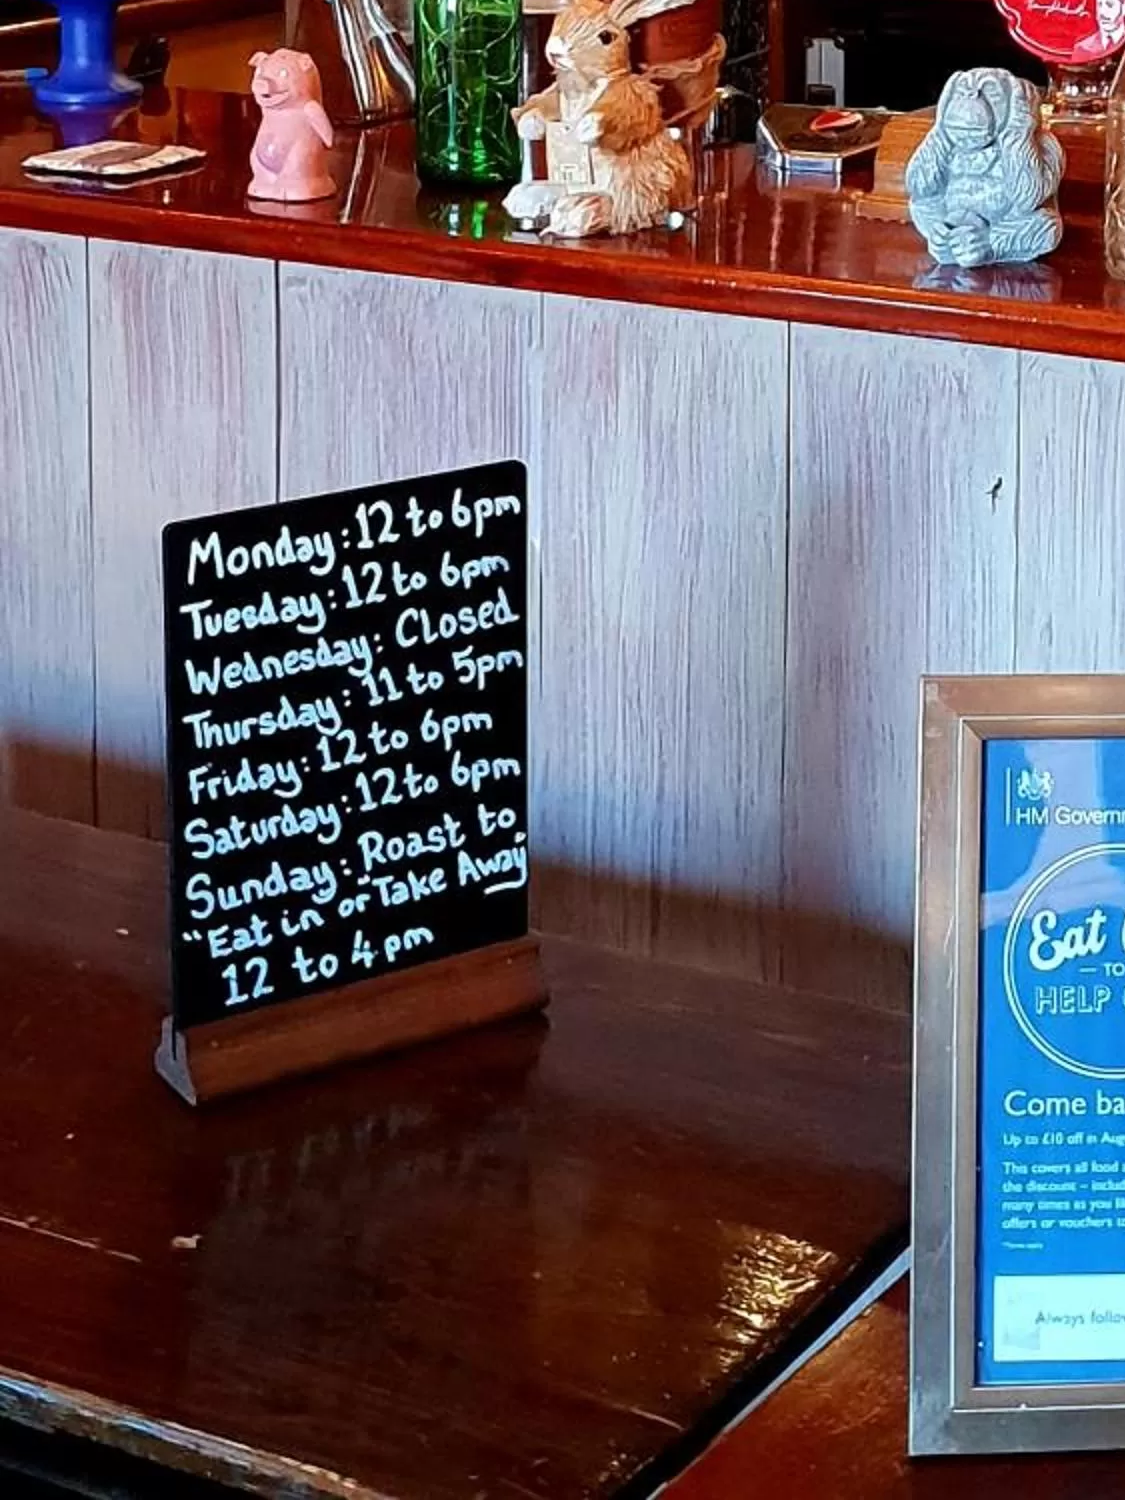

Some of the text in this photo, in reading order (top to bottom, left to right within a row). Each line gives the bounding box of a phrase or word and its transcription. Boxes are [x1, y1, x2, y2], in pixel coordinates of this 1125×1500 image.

[355, 500, 400, 549] 12
[405, 496, 443, 537] to
[451, 488, 522, 537] 6pm
[341, 562, 387, 609] 12
[392, 560, 427, 596] to
[440, 551, 511, 590] 6pm
[395, 587, 520, 647] Closed
[361, 667, 403, 707] 11
[407, 663, 444, 695] to
[452, 645, 524, 690] 5pm
[317, 729, 366, 773] 12
[368, 720, 409, 756] to
[421, 708, 493, 751] 6pm
[355, 767, 403, 812] 12
[402, 763, 439, 799] to
[450, 751, 521, 792] 6pm
[358, 813, 466, 871] Roast
[477, 804, 516, 836] to
[1016, 807, 1049, 825] HM
[281, 909, 325, 937] in
[337, 894, 372, 918] or
[1028, 908, 1108, 971] Eat
[221, 956, 275, 1006] 12
[291, 946, 339, 983] to
[1035, 982, 1113, 1016] HELP
[1003, 1090, 1087, 1117] Come
[1002, 1132, 1022, 1148] Up
[1025, 1134, 1039, 1146] to
[1041, 1132, 1063, 1146] £10
[1066, 1131, 1085, 1146] off
[1002, 1161, 1028, 1175] This
[1031, 1163, 1071, 1175] covers
[1091, 1160, 1119, 1173] food
[1002, 1180, 1023, 1193] the
[1025, 1179, 1077, 1192] discount
[1002, 1200, 1035, 1214] many
[1089, 1200, 1113, 1213] you
[1002, 1217, 1038, 1229] offers
[1040, 1218, 1056, 1229] or
[1058, 1216, 1113, 1229] vouchers
[1034, 1309, 1085, 1329] Always
